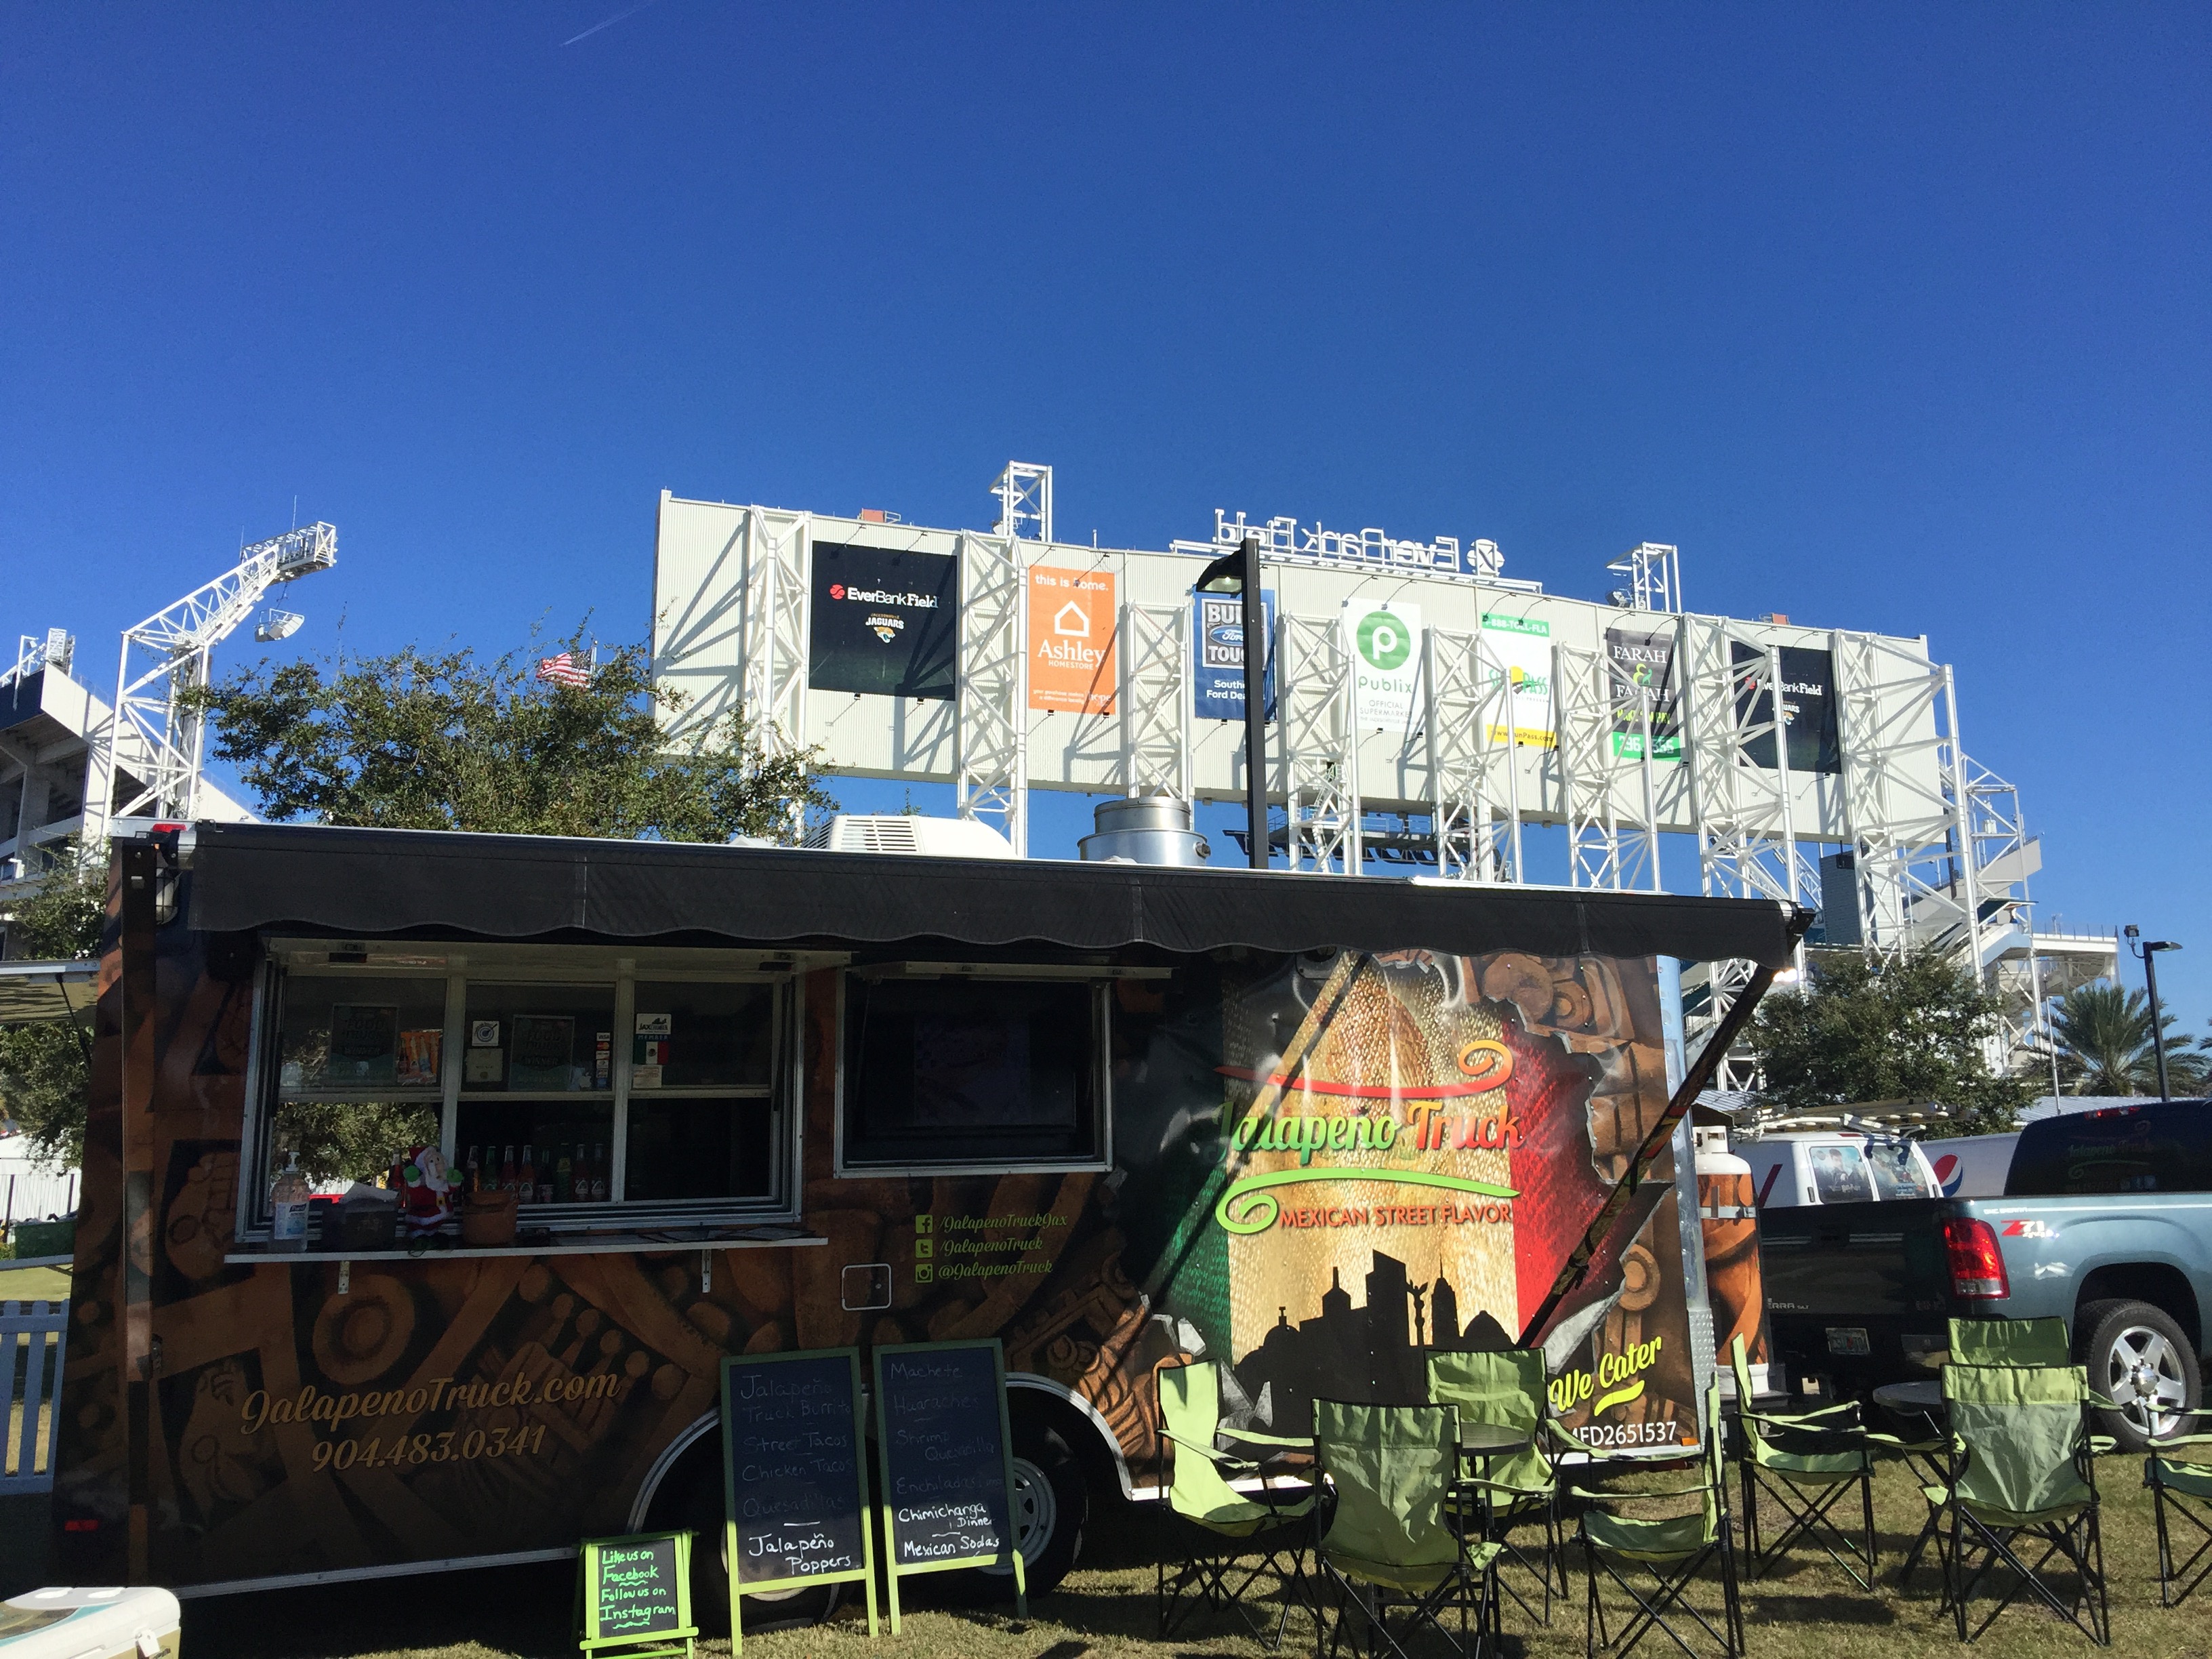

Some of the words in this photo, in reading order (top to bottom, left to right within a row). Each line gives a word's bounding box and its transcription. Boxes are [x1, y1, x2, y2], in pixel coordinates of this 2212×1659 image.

[1035, 574, 1057, 586] this
[1060, 577, 1069, 588] is
[865, 617, 905, 630] JAGUARS
[1207, 604, 1243, 624] BUI
[1037, 639, 1106, 668] Ashley
[1208, 645, 1244, 663] TOU
[1613, 645, 1667, 663] FARAH
[1048, 660, 1094, 670] HOMESTORE
[1206, 689, 1228, 699] Ford
[1214, 680, 1246, 689] South
[1358, 676, 1412, 693] Publix
[1616, 684, 1671, 702] FAAH
[1369, 699, 1404, 710] OFFICIAL
[1407, 1101, 1524, 1150] Truck
[938, 1213, 1069, 1233] /JalapenoTruckJax
[1279, 1208, 1367, 1229] MEXICAN
[1375, 1206, 1436, 1226] STREET
[1441, 1204, 1511, 1223] FLAVOR
[939, 1237, 1044, 1257] /JalapenoTruck
[938, 1259, 1053, 1281] @JalapenoTruck
[890, 1361, 963, 1380] Machete
[1549, 1369, 1594, 1412] We
[1599, 1336, 1662, 1389] Cater
[240, 1372, 622, 1435] JalapenoTruck.com
[743, 1405, 795, 1424] Truck
[311, 1425, 548, 1473] 904.483.0341
[742, 1435, 802, 1454] Street
[802, 1431, 847, 1448] Tacos
[742, 1464, 806, 1481] Chicken
[810, 1458, 853, 1473] Tacos
[898, 1503, 987, 1522] Chimichanga
[956, 1517, 994, 1528] Dinner
[904, 1540, 956, 1557] Mexican
[960, 1535, 1000, 1550] Sodas
[602, 1550, 626, 1565] Like
[626, 1551, 638, 1561] us
[640, 1550, 654, 1561] on
[785, 1555, 851, 1575] Poppers
[602, 1564, 659, 1584] Facebook
[600, 1588, 636, 1603] Follow
[637, 1588, 649, 1597] us
[652, 1587, 667, 1596] on
[599, 1604, 676, 1622] Instagram
